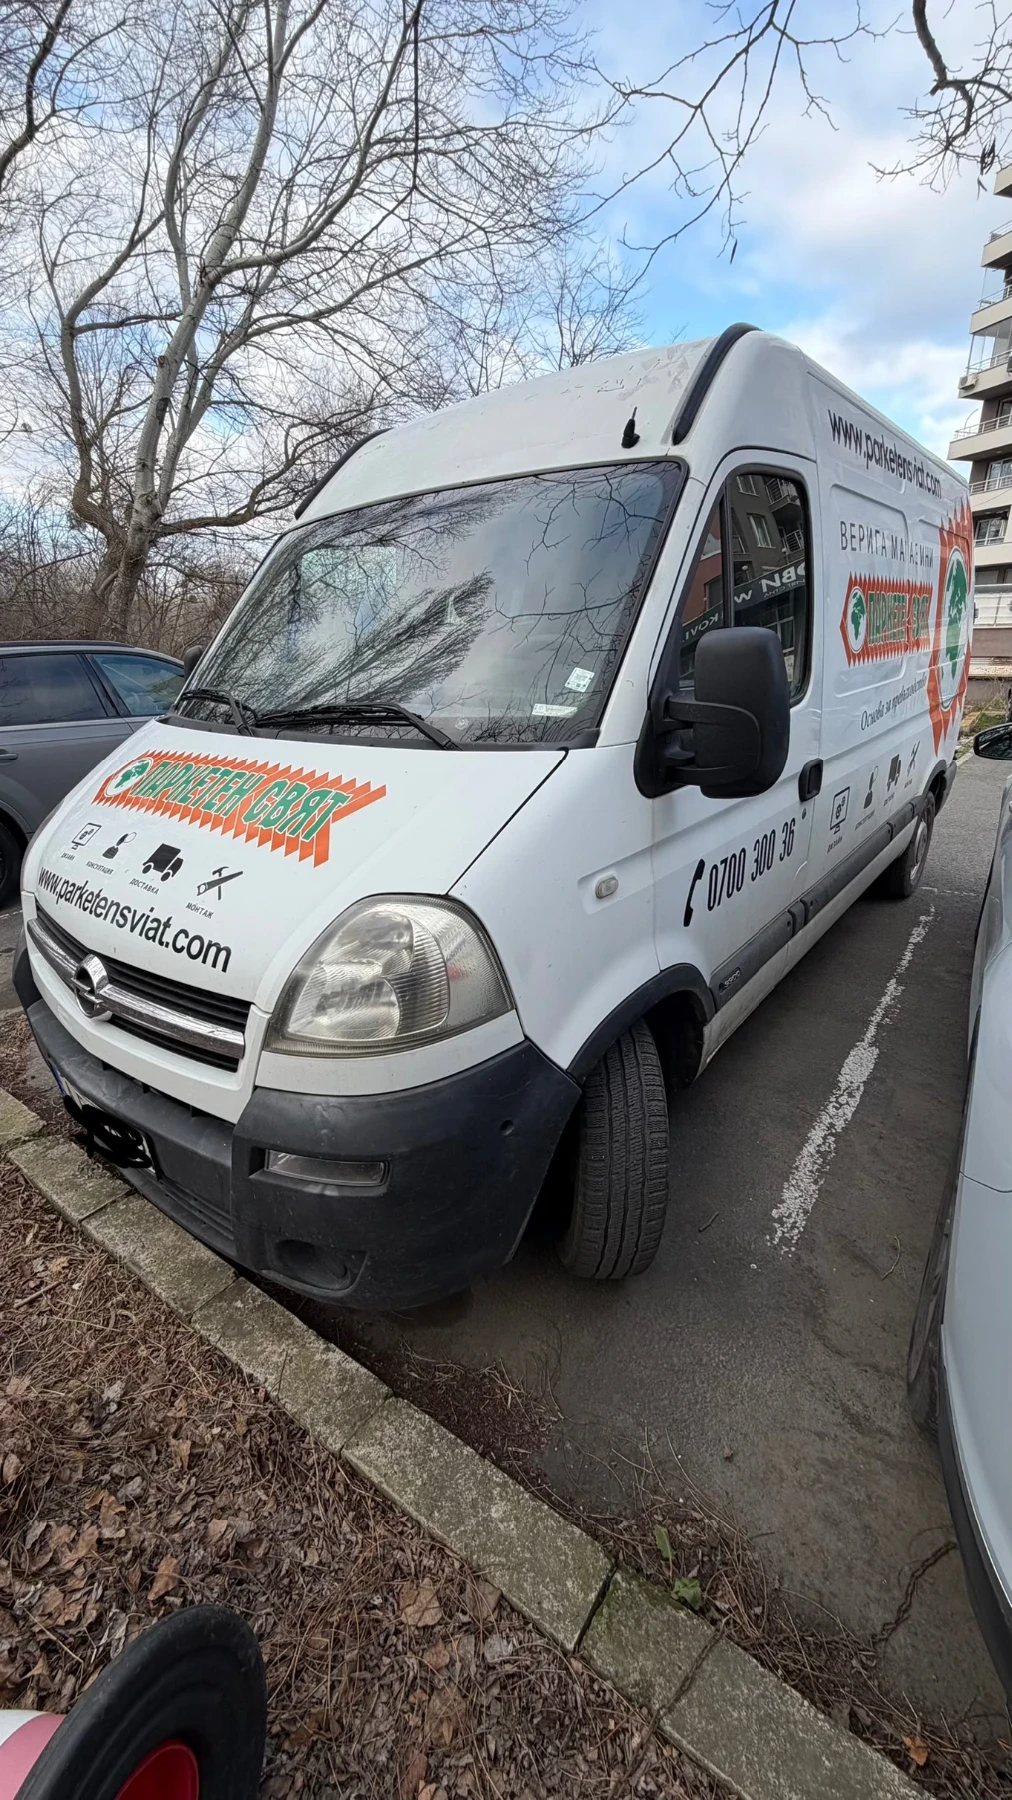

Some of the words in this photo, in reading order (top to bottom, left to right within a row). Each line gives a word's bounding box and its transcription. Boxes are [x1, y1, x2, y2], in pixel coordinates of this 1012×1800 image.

[827, 408, 943, 500] www.parketensviat.com
[840, 520, 888, 558] ВЕРИГА
[867, 591, 908, 647] ПАРКЕТЕ
[129, 759, 264, 818] ПАРКЕТЕН
[243, 778, 352, 842] СВЯТ
[128, 877, 160, 896] ДОСТАВКА
[707, 847, 747, 912] 0700
[751, 828, 776, 882] 300
[779, 817, 797, 863] 36
[37, 866, 233, 974] www.parketensviat.com
[184, 902, 215, 920] МОНТАЖ
